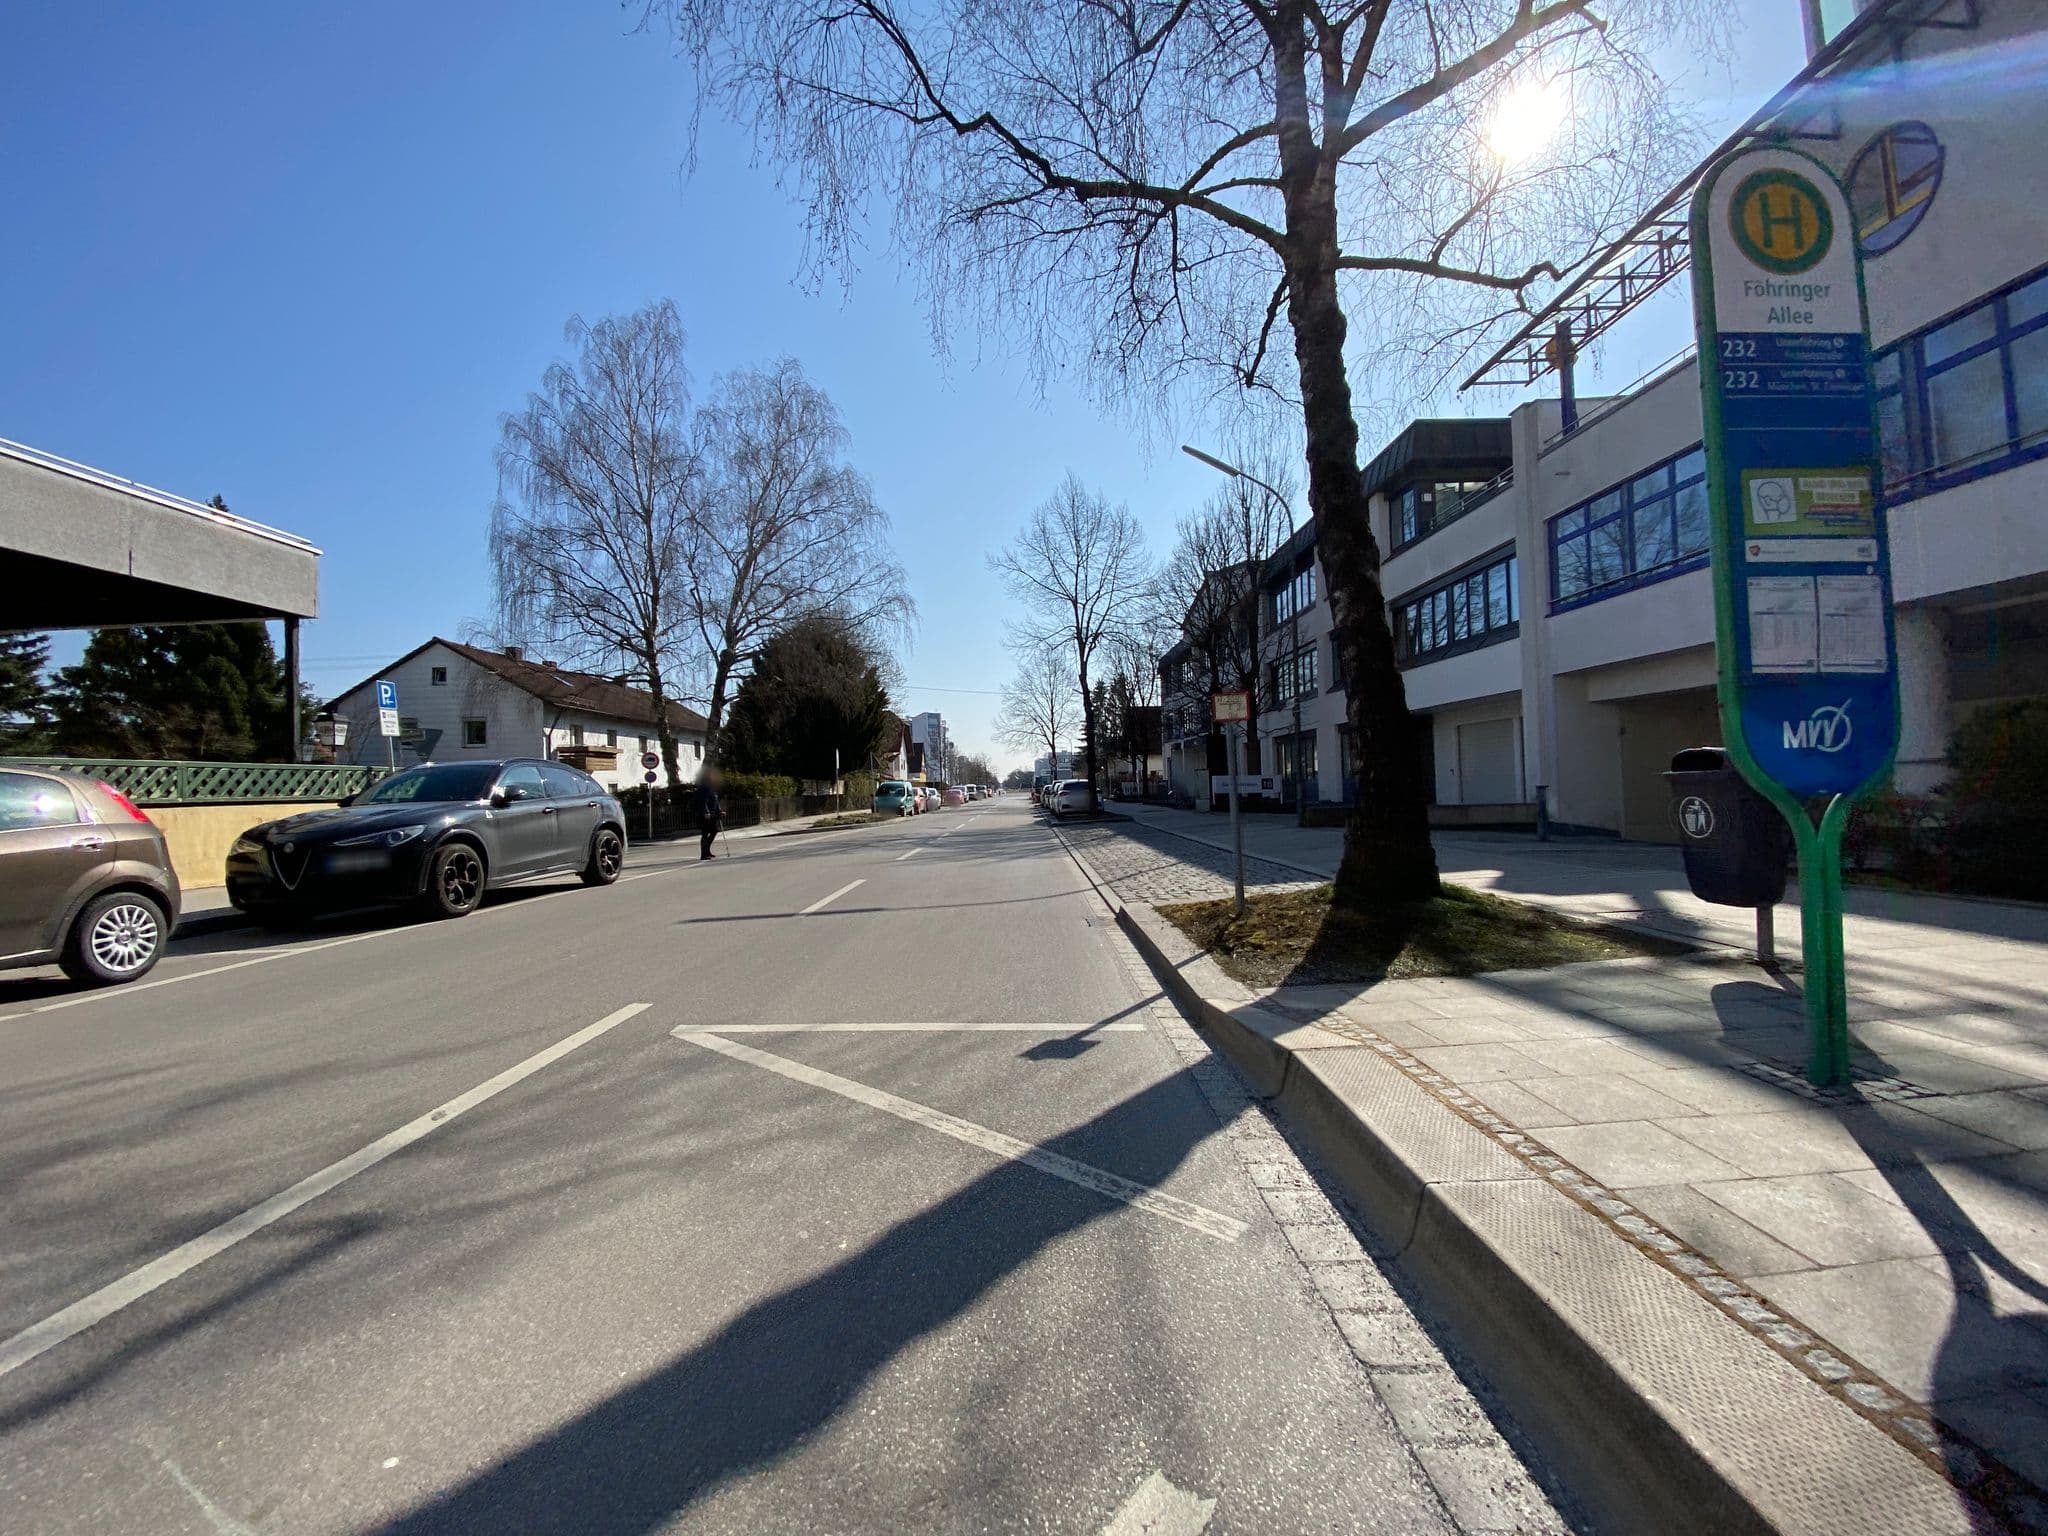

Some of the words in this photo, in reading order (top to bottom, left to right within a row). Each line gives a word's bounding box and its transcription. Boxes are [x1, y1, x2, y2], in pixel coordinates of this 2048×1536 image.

[1758, 191, 1804, 250] H
[1744, 278, 1830, 302] Föhringer
[1767, 305, 1814, 324] Allee
[1722, 339, 1757, 358] 232
[1724, 371, 1760, 389] 232
[380, 684, 391, 705] P
